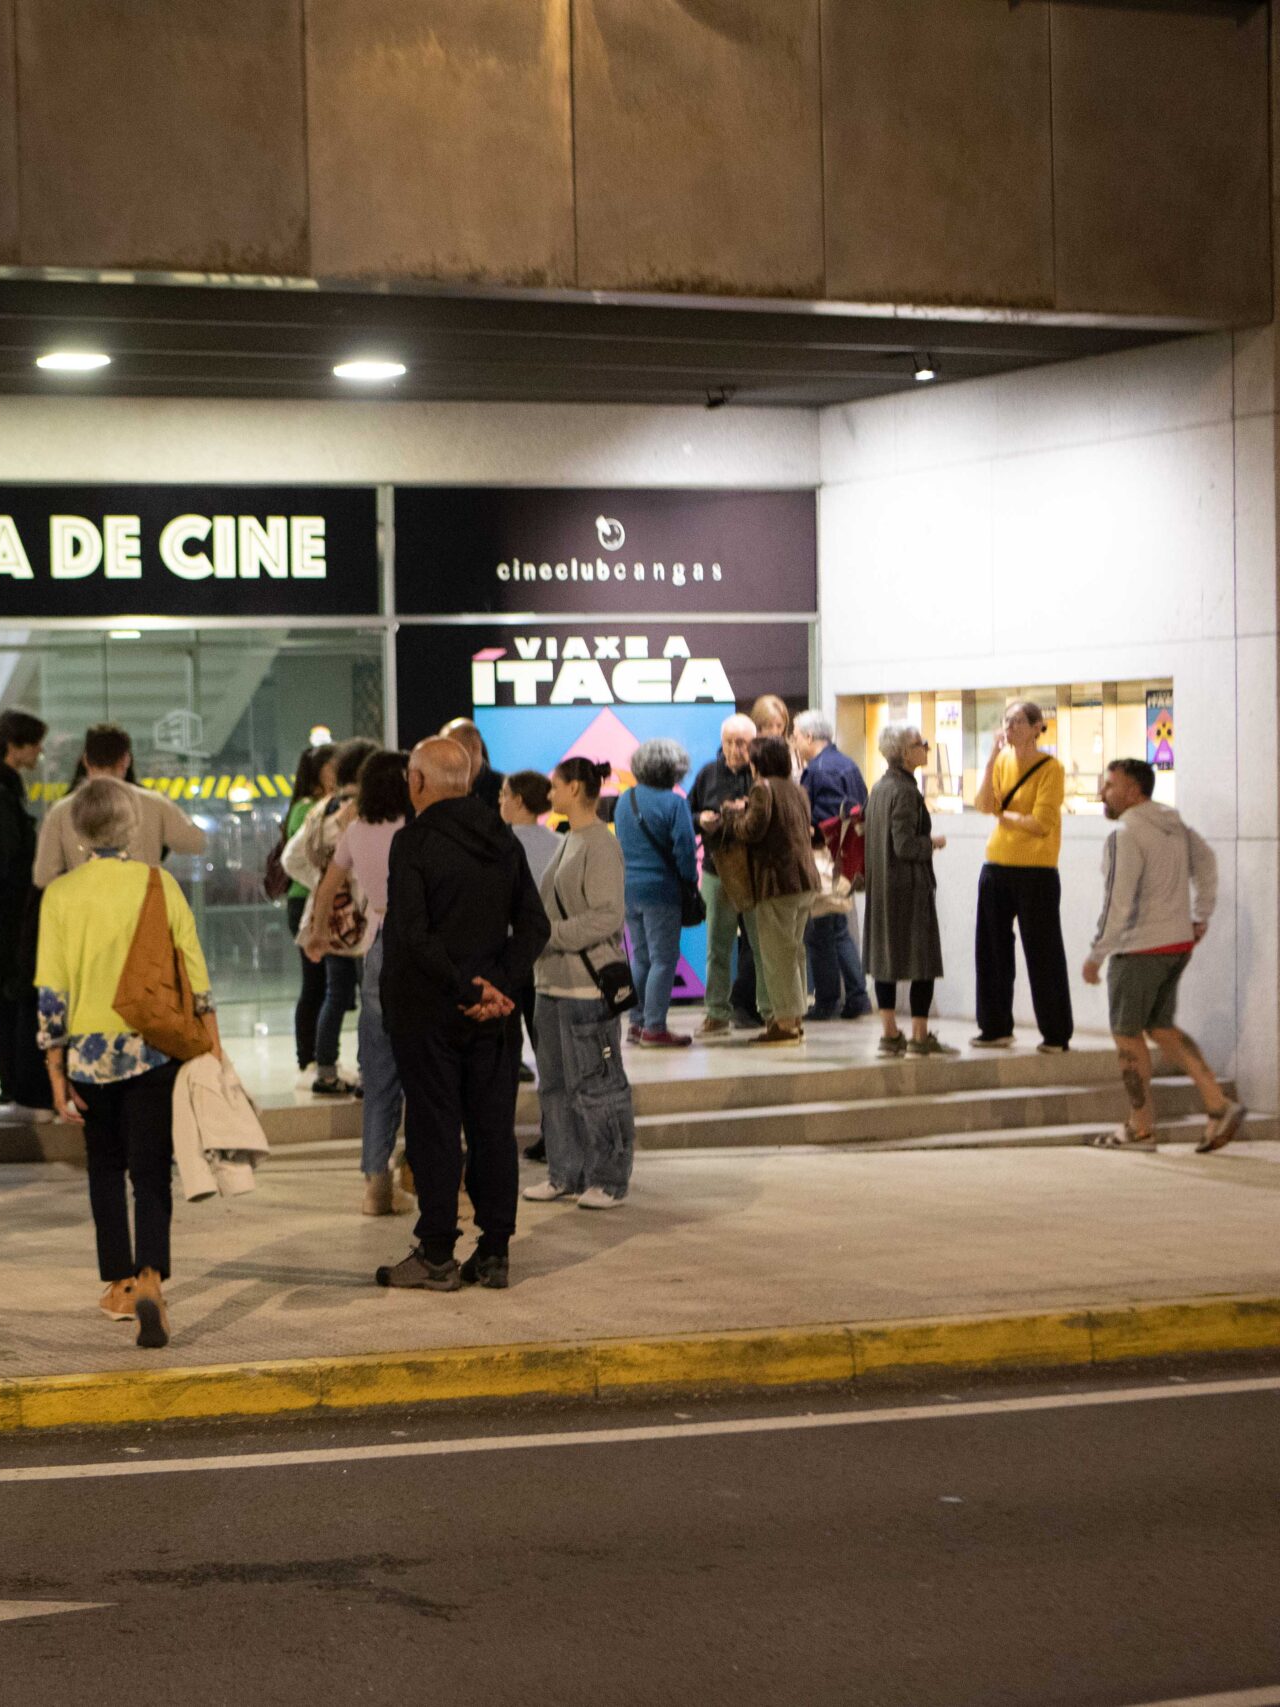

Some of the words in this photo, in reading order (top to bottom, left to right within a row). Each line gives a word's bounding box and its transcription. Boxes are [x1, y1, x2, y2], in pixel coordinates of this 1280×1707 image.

[50, 514, 142, 580] DE
[159, 513, 327, 581] CINE
[472, 647, 736, 705] ÍTACA
[513, 635, 649, 660] VIAXE
[662, 635, 691, 659] A
